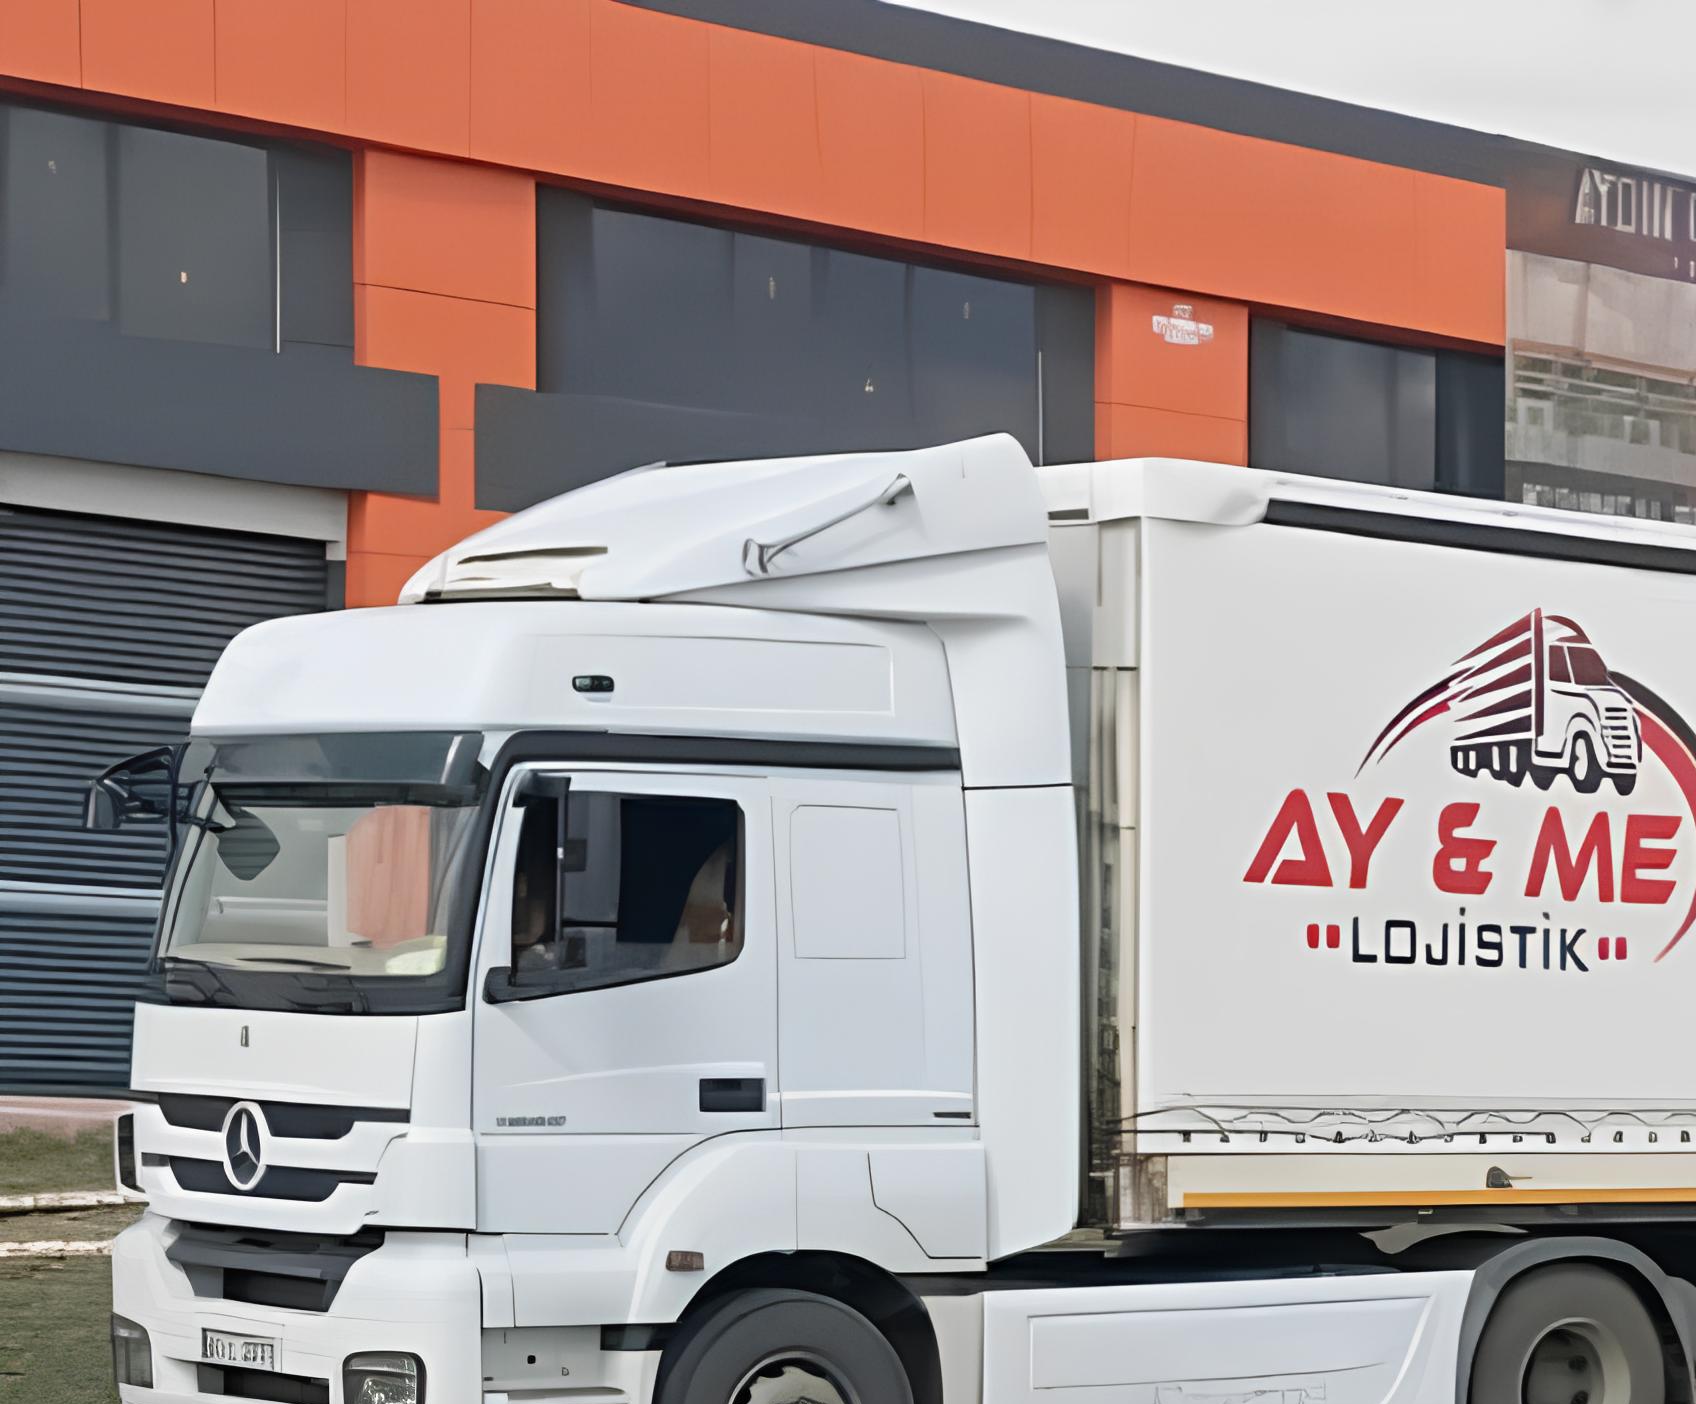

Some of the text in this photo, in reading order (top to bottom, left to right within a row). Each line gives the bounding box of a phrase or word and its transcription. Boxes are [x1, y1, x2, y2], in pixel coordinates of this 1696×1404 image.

[1242, 787, 1684, 905] AY & ME
[1351, 906, 1589, 972] LOJİSTİK
